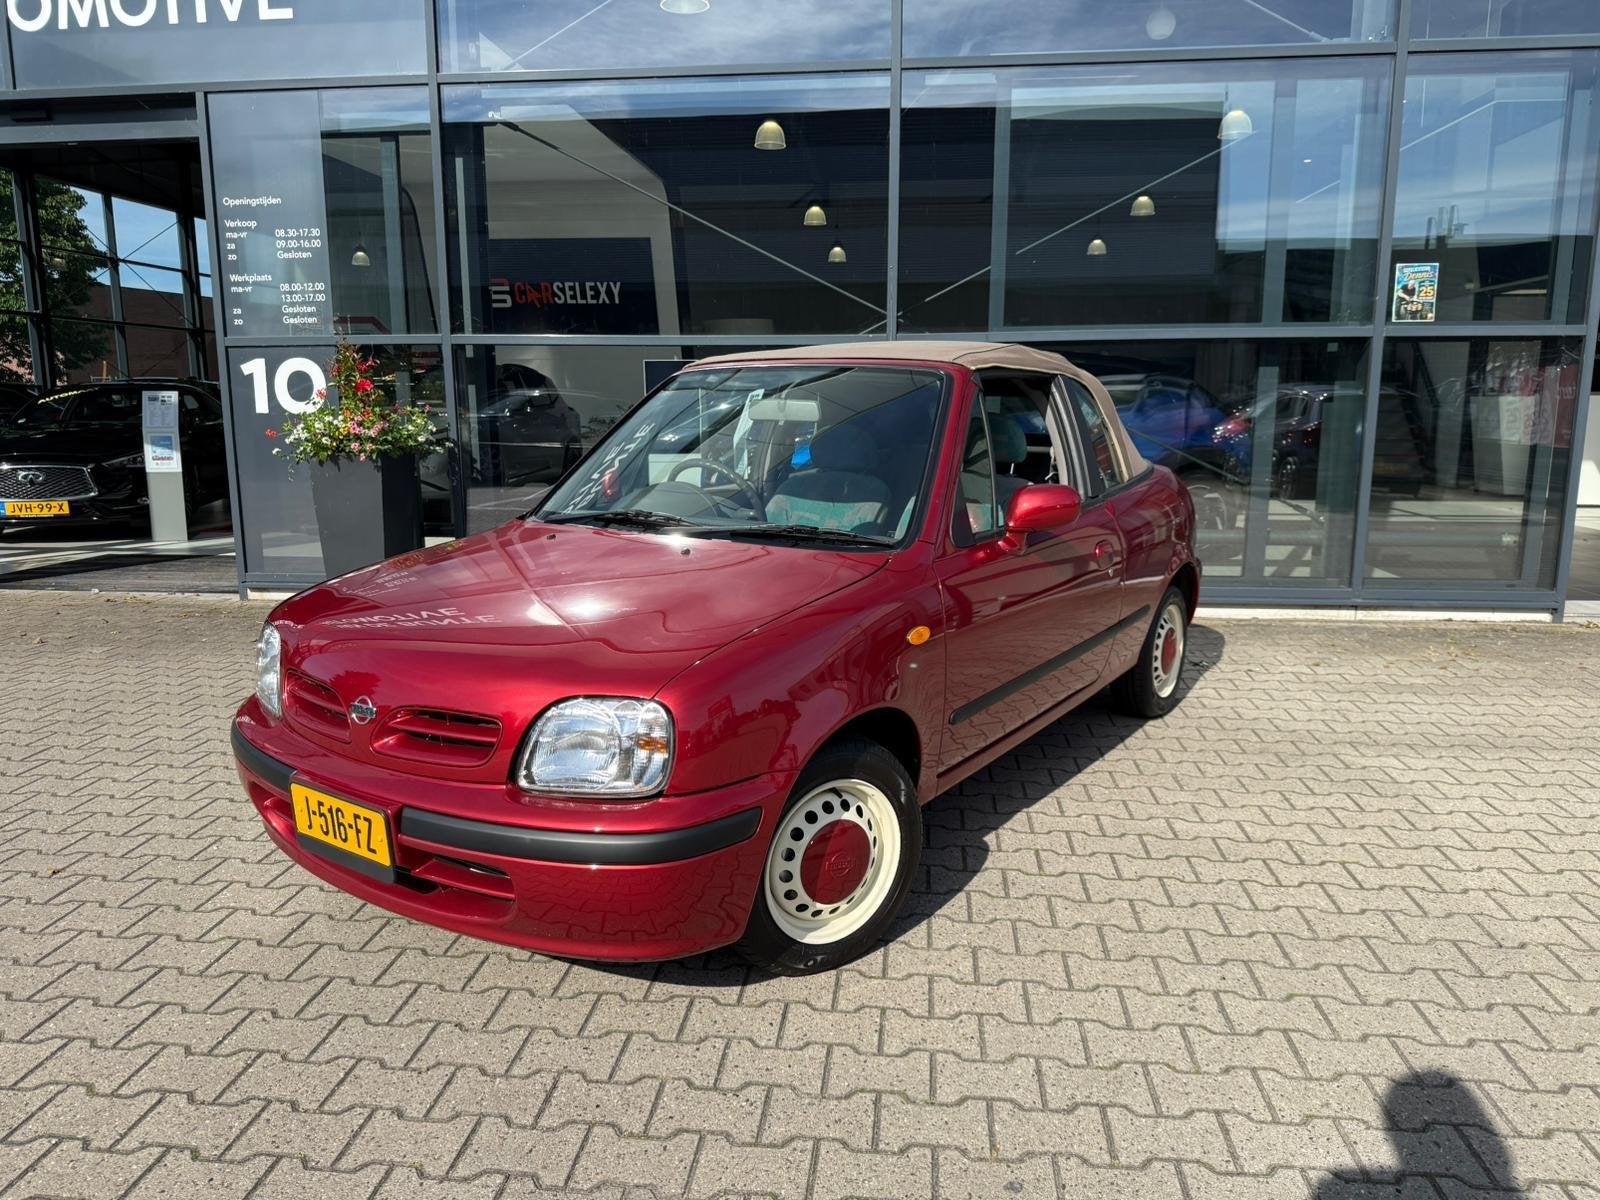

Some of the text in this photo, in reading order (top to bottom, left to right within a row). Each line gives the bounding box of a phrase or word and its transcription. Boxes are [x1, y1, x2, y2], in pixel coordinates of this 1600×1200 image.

[222, 195, 282, 208] Openingstijden
[224, 219, 258, 230] Verkoop
[225, 228, 321, 239] ma-vr 08.30-17.30
[275, 239, 322, 249] 09.00-16.00
[276, 250, 312, 259] Gesloten
[229, 273, 273, 284] Werkplaats
[279, 282, 325, 292] 08.00-12.00
[1419, 287, 1435, 297] 25
[280, 293, 326, 302] 13.00-17.00
[281, 304, 317, 314] Gesloten
[282, 315, 318, 324] Gesloten
[240, 357, 327, 415] 10
[10, 502, 65, 513] JVH-99-X
[304, 795, 377, 855] J-516-FZ
